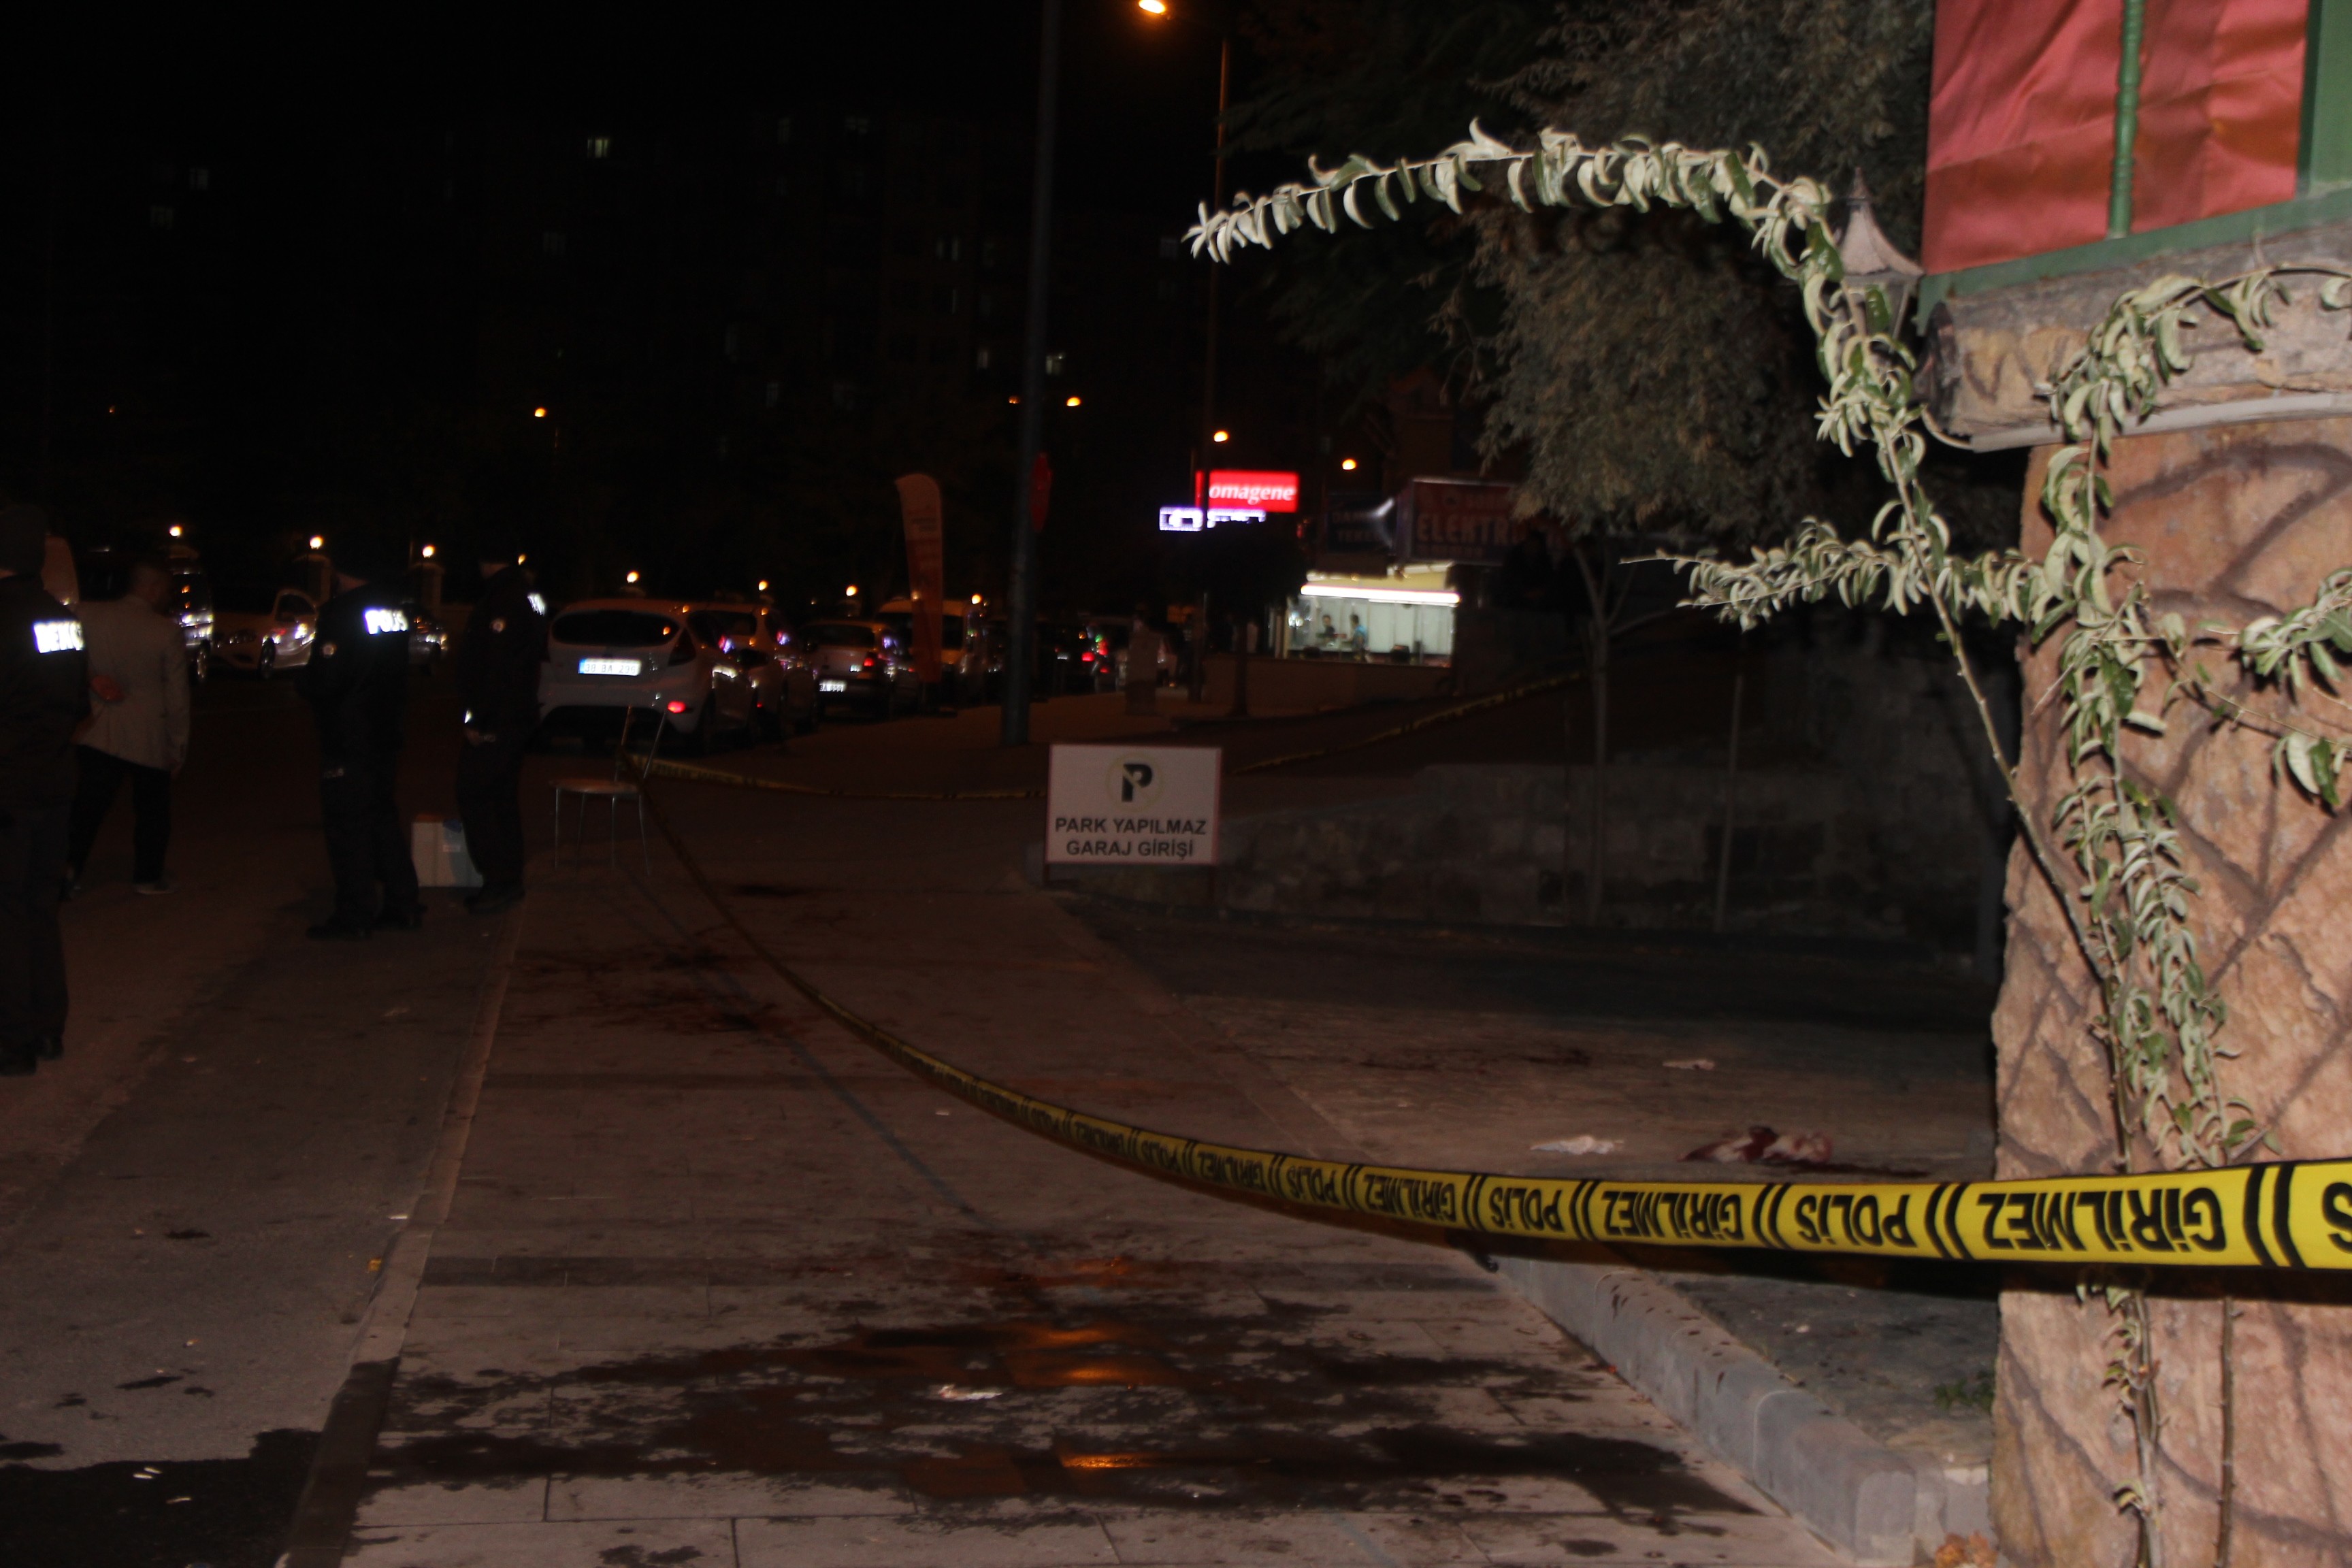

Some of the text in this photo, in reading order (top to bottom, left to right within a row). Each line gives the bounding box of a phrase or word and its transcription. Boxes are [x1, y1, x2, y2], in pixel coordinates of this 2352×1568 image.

[1199, 484, 1296, 505] omagene
[1055, 818, 1207, 835] PARK YAPILMAZ
[1066, 839, 1193, 861] GARAJ GİRİŞİ
[1286, 1165, 1341, 1205] POLİS
[1363, 1173, 1456, 1222] GİRİLMEZ
[1489, 1186, 1562, 1232] POLİS
[1601, 1190, 1745, 1241] GİRİLMEZ
[1795, 1193, 1918, 1248] POLİS
[1977, 1186, 2227, 1253] GİRİLMEZ
